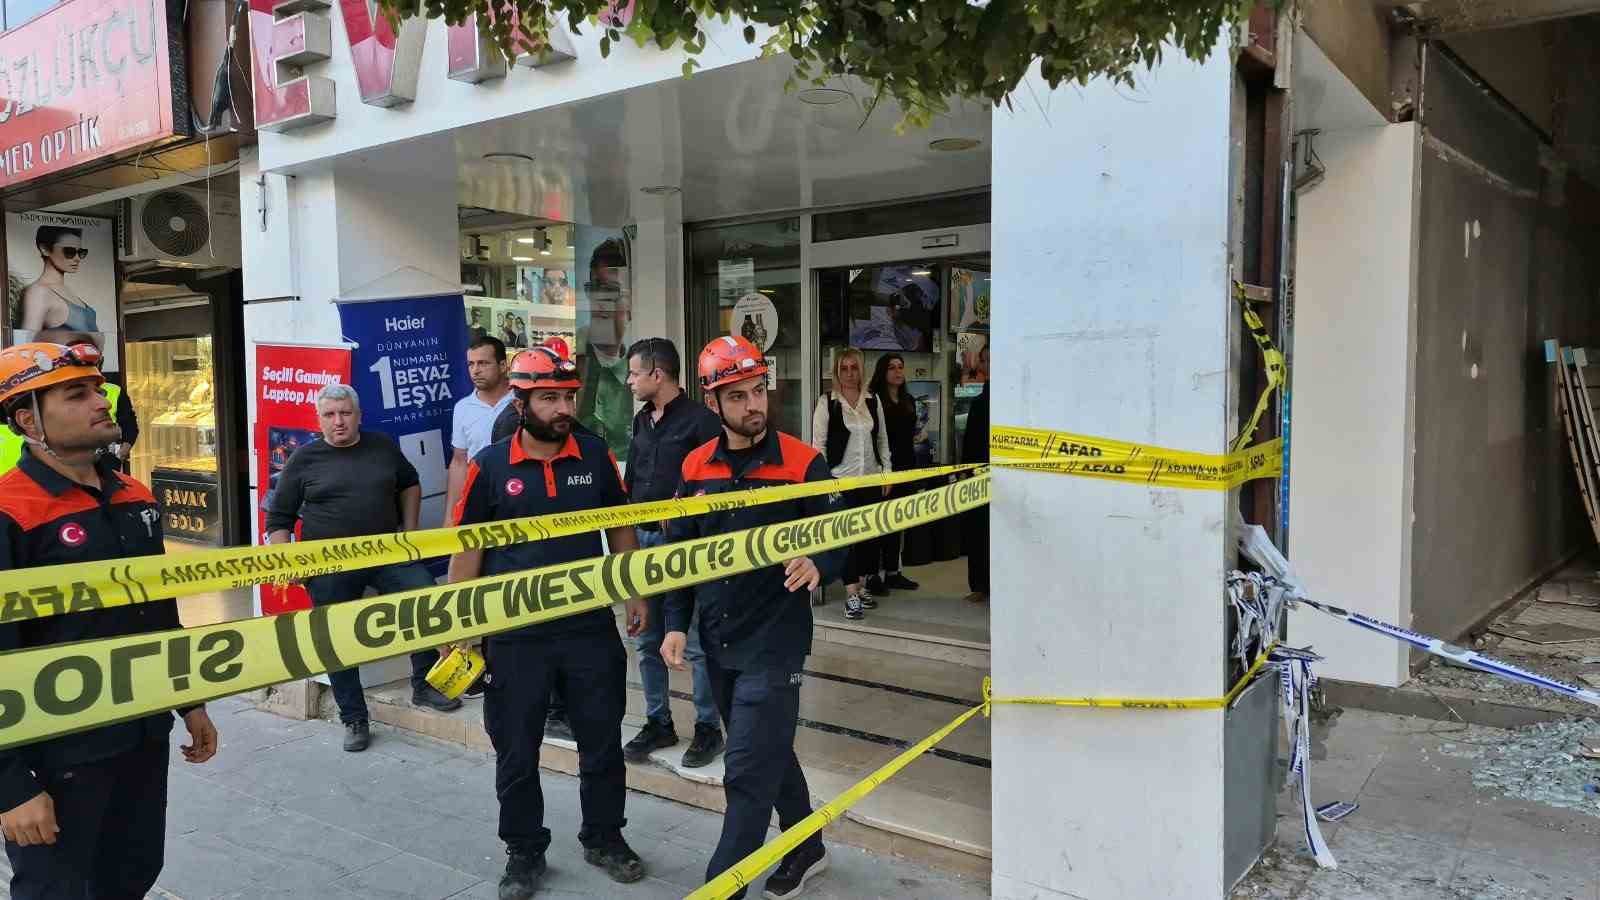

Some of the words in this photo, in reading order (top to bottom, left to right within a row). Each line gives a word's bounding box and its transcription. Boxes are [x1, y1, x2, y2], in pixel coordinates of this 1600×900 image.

[41, 113, 101, 164] OPTİK
[385, 315, 425, 332] Haier
[377, 337, 438, 352] DÜNYANIN
[393, 353, 447, 367] NUMARALI
[263, 366, 294, 384] Seçili
[369, 356, 396, 409] 1
[395, 364, 451, 385] BEYAZ
[263, 385, 305, 406] Laptop
[397, 382, 452, 408] EŞYA
[567, 474, 593, 486] AFAD
[169, 513, 206, 532] GOLD
